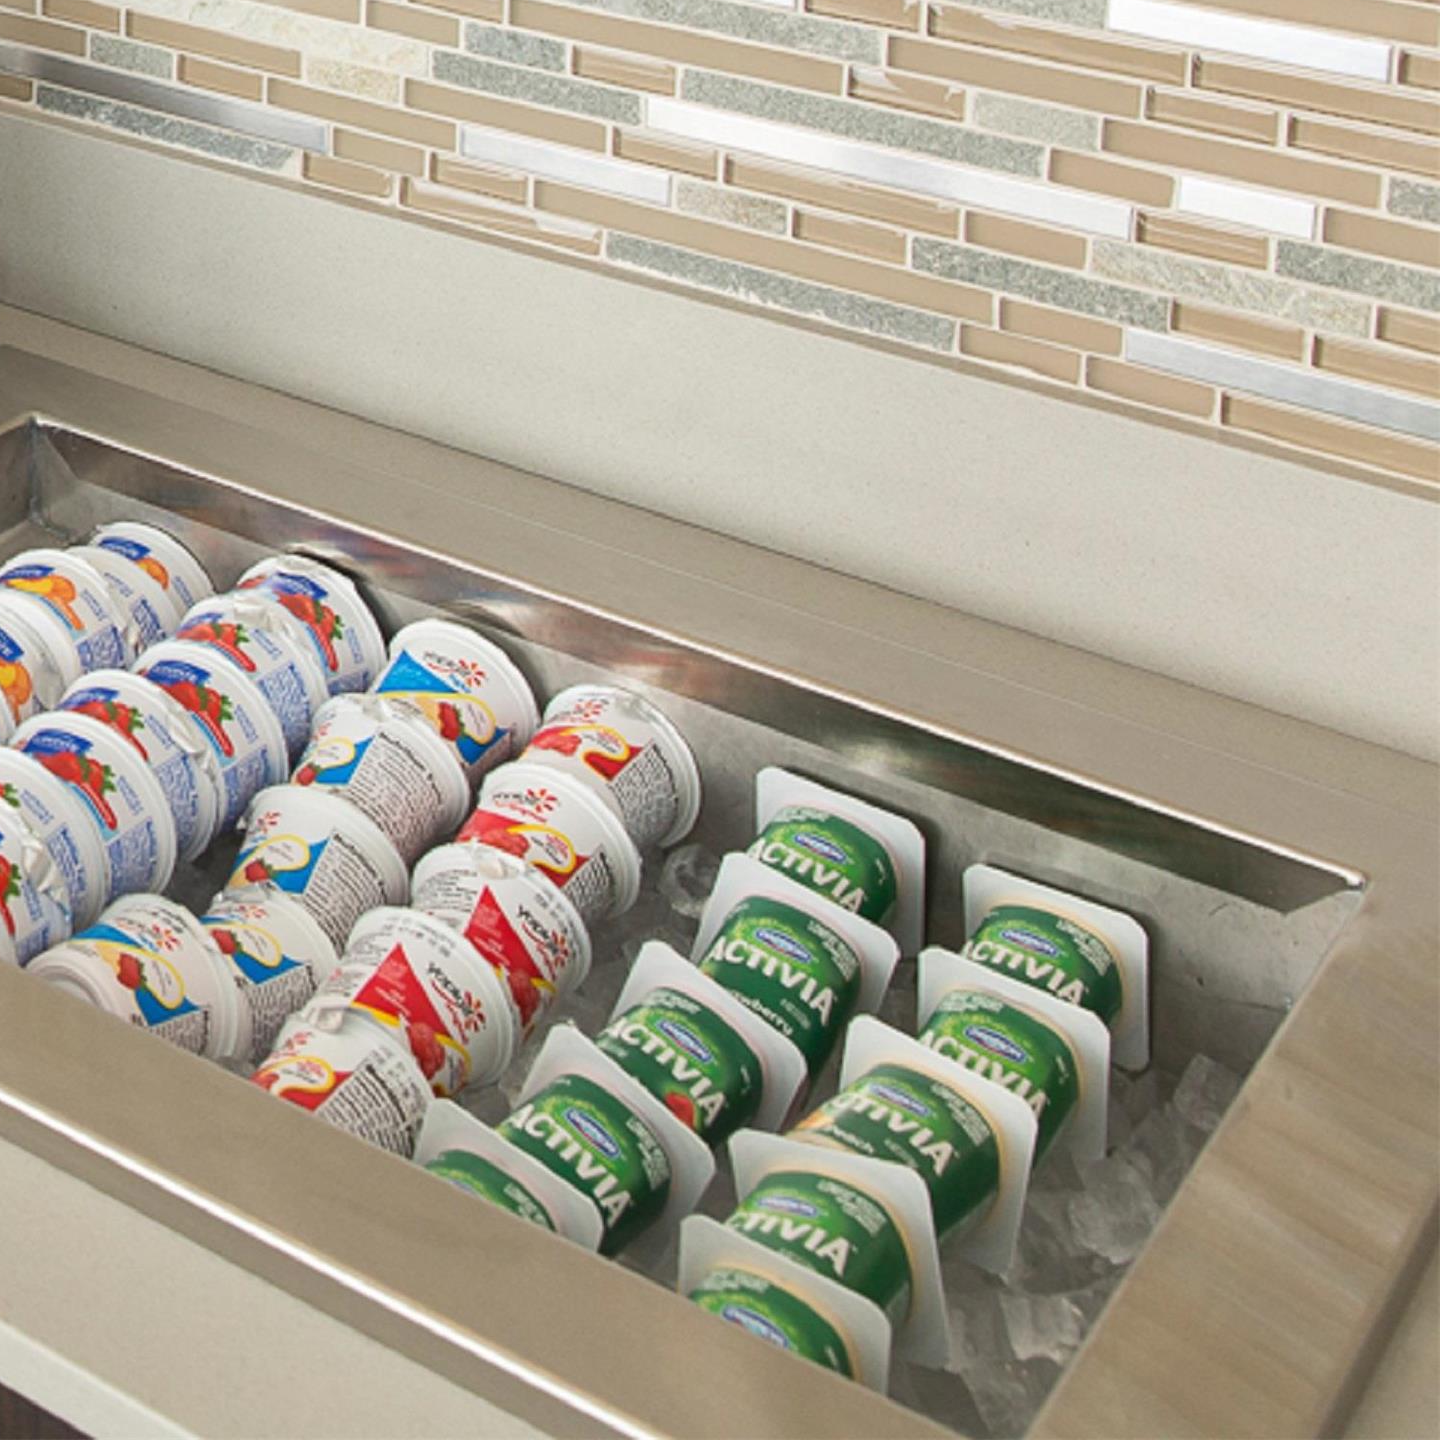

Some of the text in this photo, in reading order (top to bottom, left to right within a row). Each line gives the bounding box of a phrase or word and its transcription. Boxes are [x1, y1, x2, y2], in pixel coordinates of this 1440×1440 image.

[704, 935, 834, 1026] ACTIVIA
[598, 1017, 726, 1127] ACTIVIA
[502, 1103, 631, 1229] ACTIVIA
